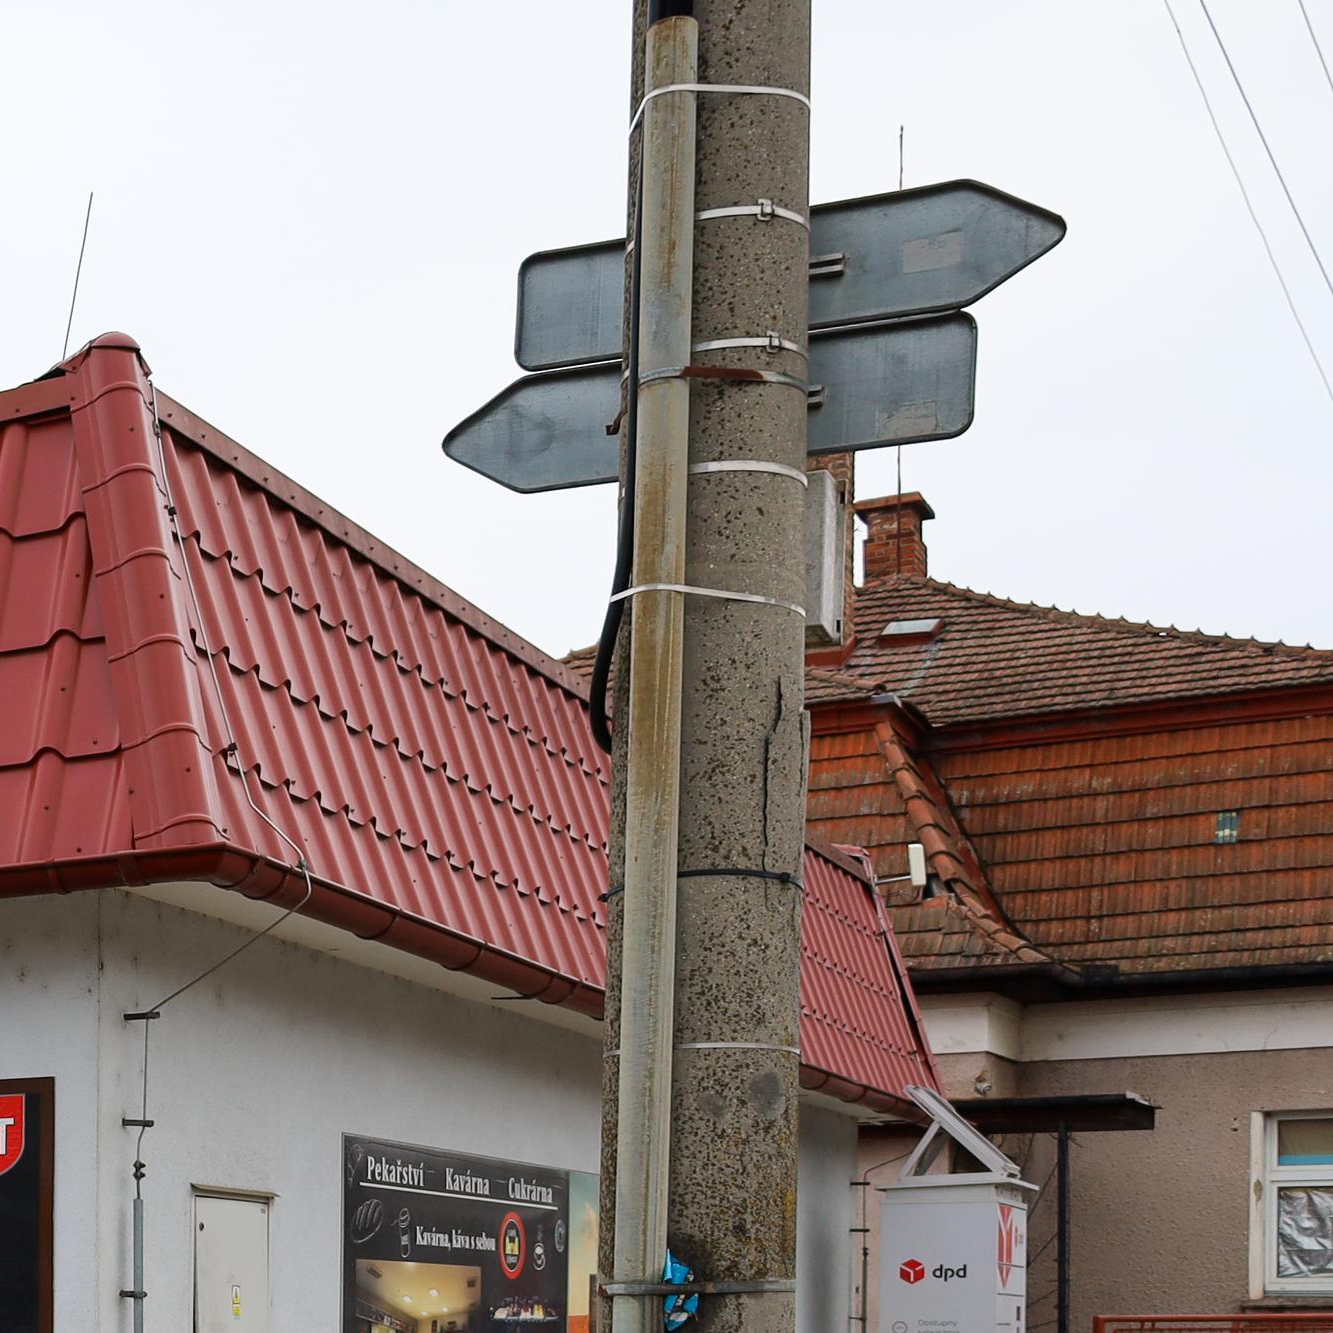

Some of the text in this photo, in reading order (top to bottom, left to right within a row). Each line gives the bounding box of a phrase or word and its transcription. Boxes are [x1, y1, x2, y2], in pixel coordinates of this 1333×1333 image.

[367, 1155, 553, 1203] Pekařství Kavárna Cukrárna
[416, 1226, 451, 1251] Kavárna,
[452, 1229, 470, 1250] káva
[476, 1233, 496, 1251] sebou
[932, 1264, 967, 1282] dpd
